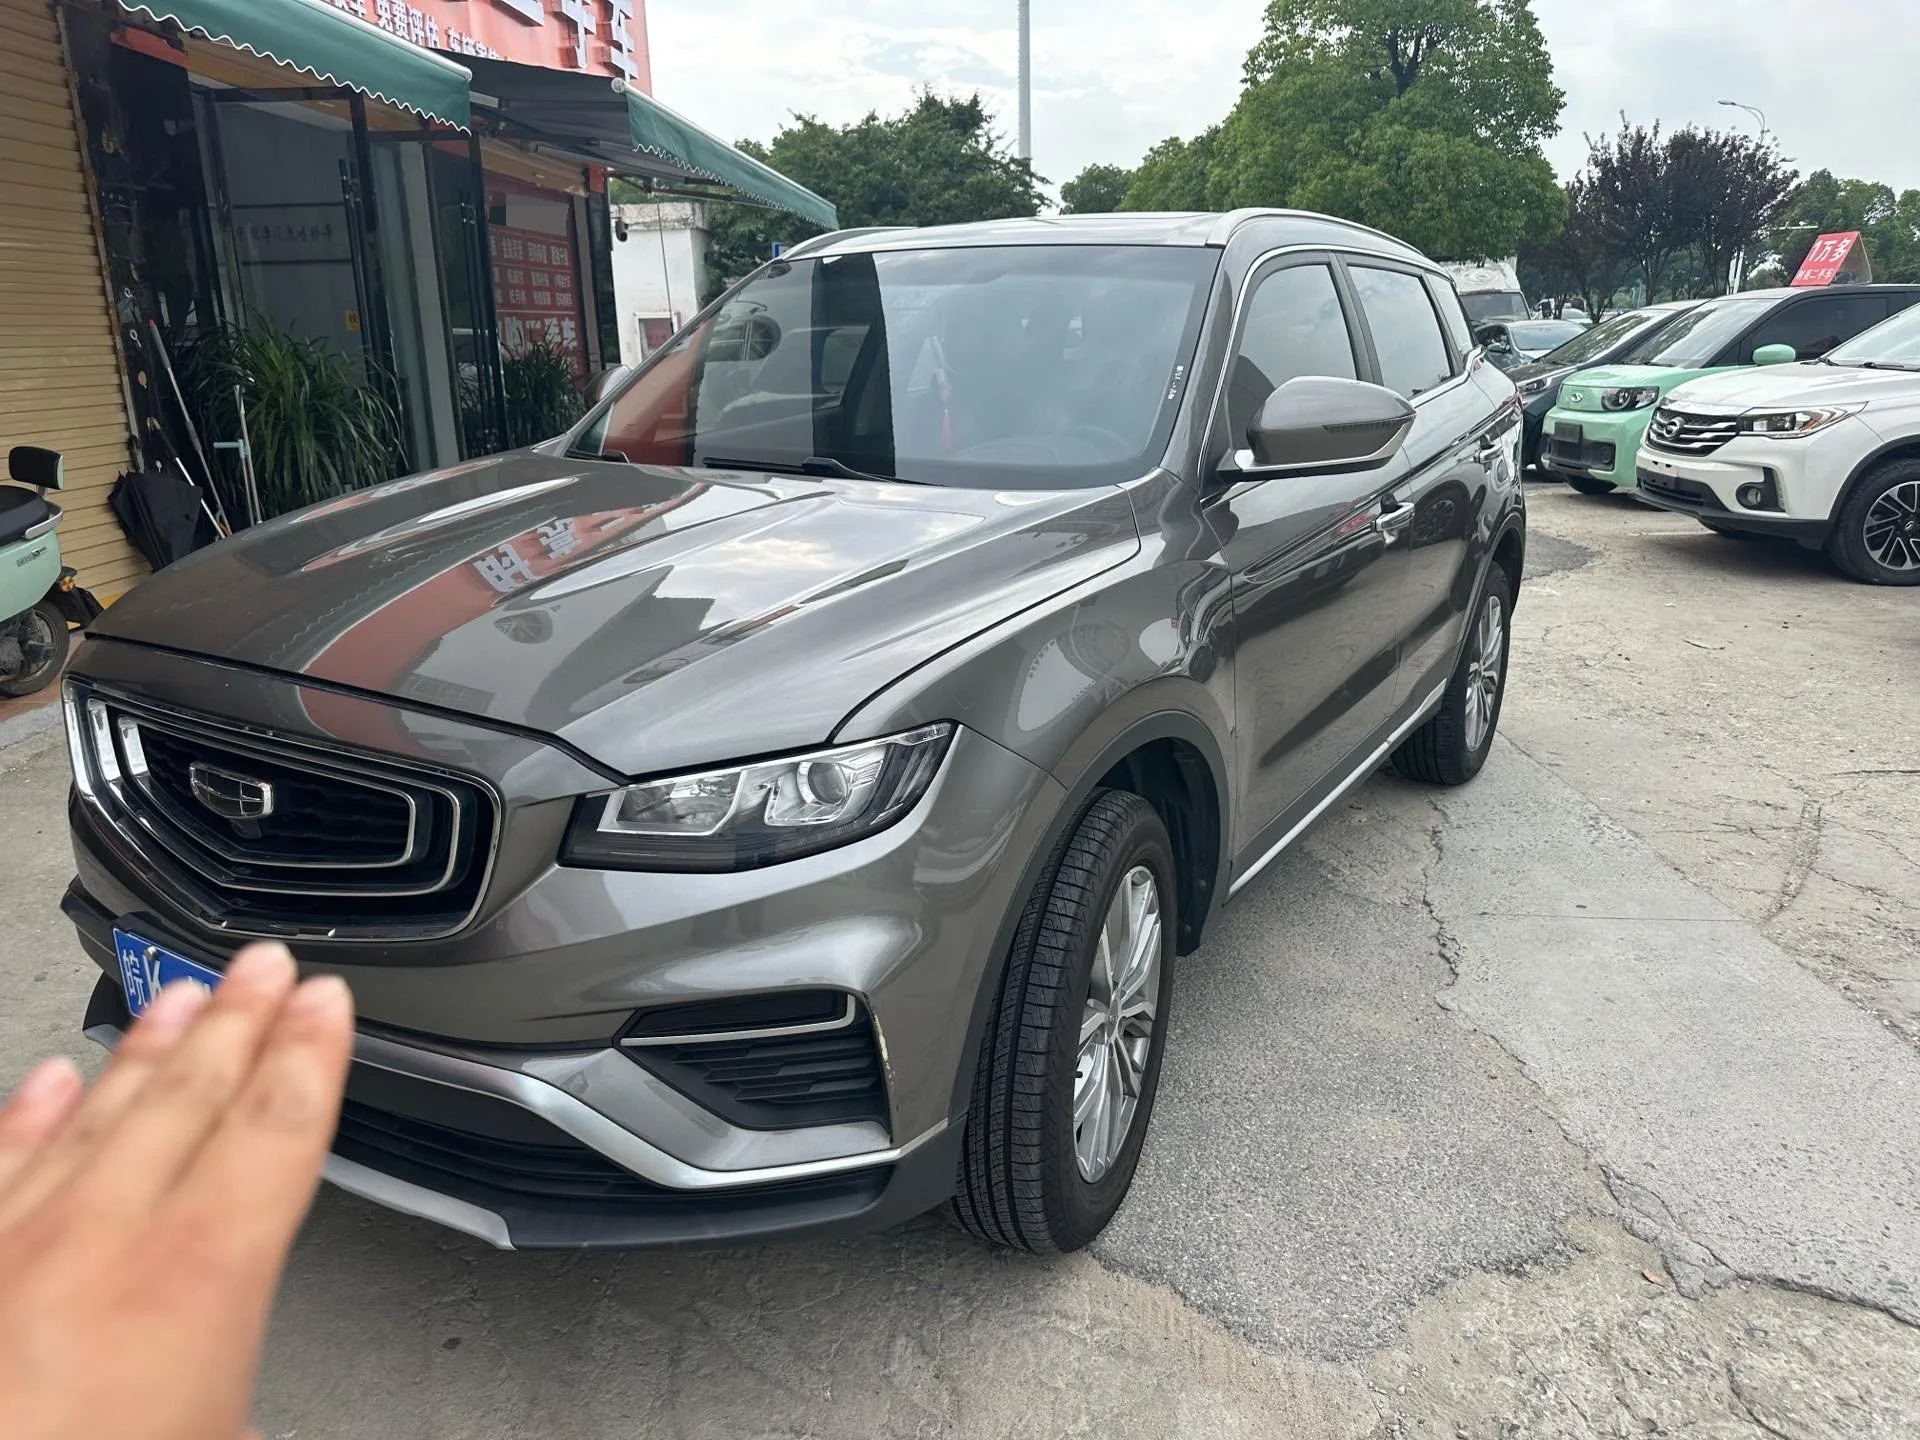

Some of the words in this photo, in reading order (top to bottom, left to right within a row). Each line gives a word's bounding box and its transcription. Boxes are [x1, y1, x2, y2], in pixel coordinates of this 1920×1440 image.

[375, 0, 440, 48] 免费评估
[1809, 238, 1851, 262] 1万多
